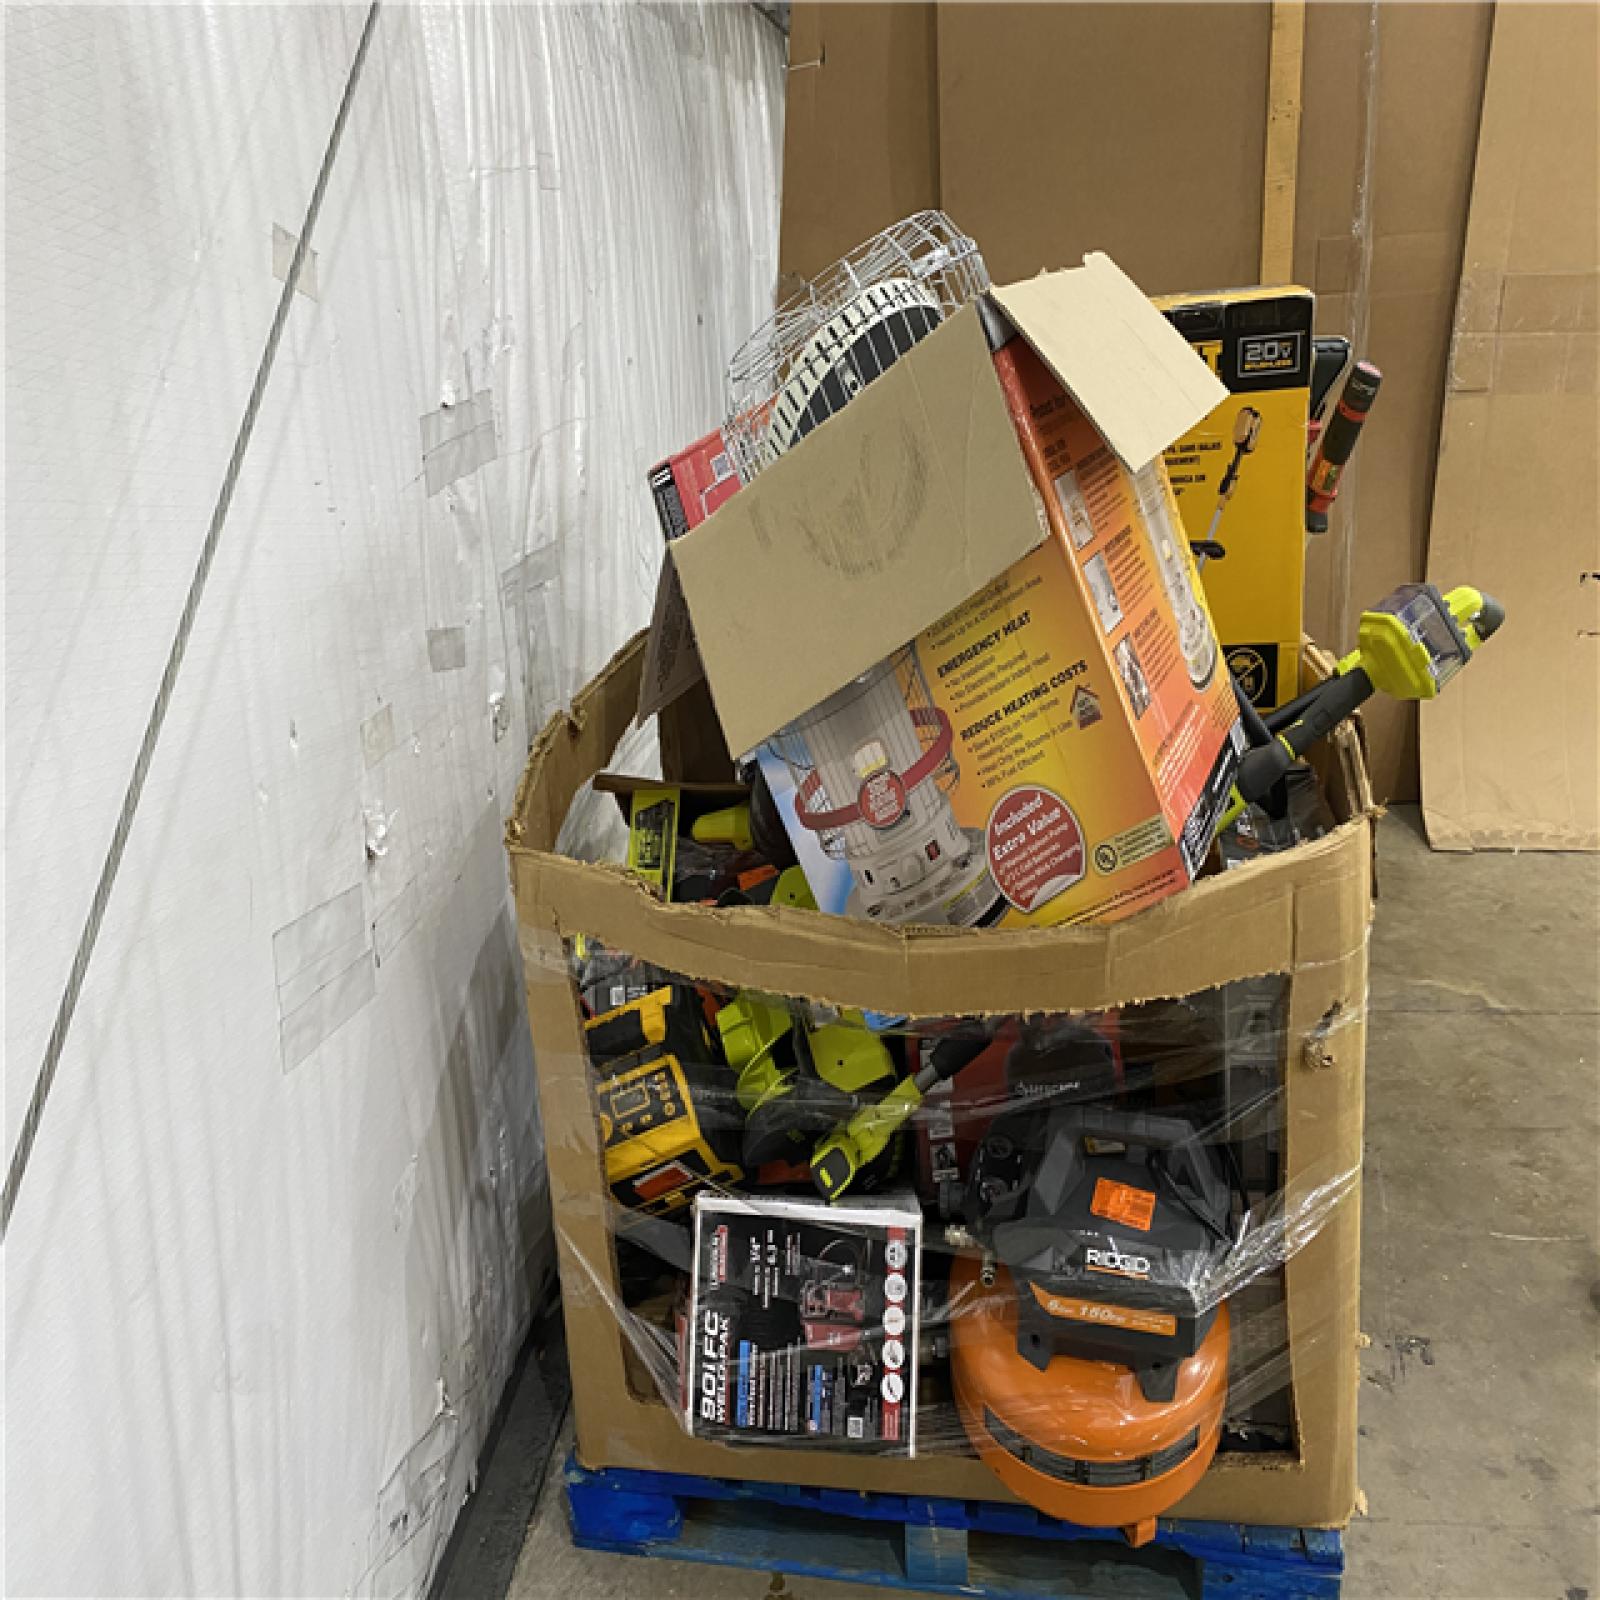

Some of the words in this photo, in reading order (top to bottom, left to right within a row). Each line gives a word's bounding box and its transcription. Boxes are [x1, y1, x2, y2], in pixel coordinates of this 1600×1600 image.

[936, 629, 1001, 678] EMERGENCY
[1001, 609, 1031, 636] HEAT
[960, 708, 1003, 741] REDUCE
[1002, 681, 1051, 717] HEATING
[1049, 659, 1088, 688] COSTS
[992, 831, 1026, 861] Extra
[1027, 807, 1061, 836] Value
[994, 791, 1043, 836] Included
[1086, 1249, 1151, 1273] RIDGID
[704, 1309, 719, 1359] FC
